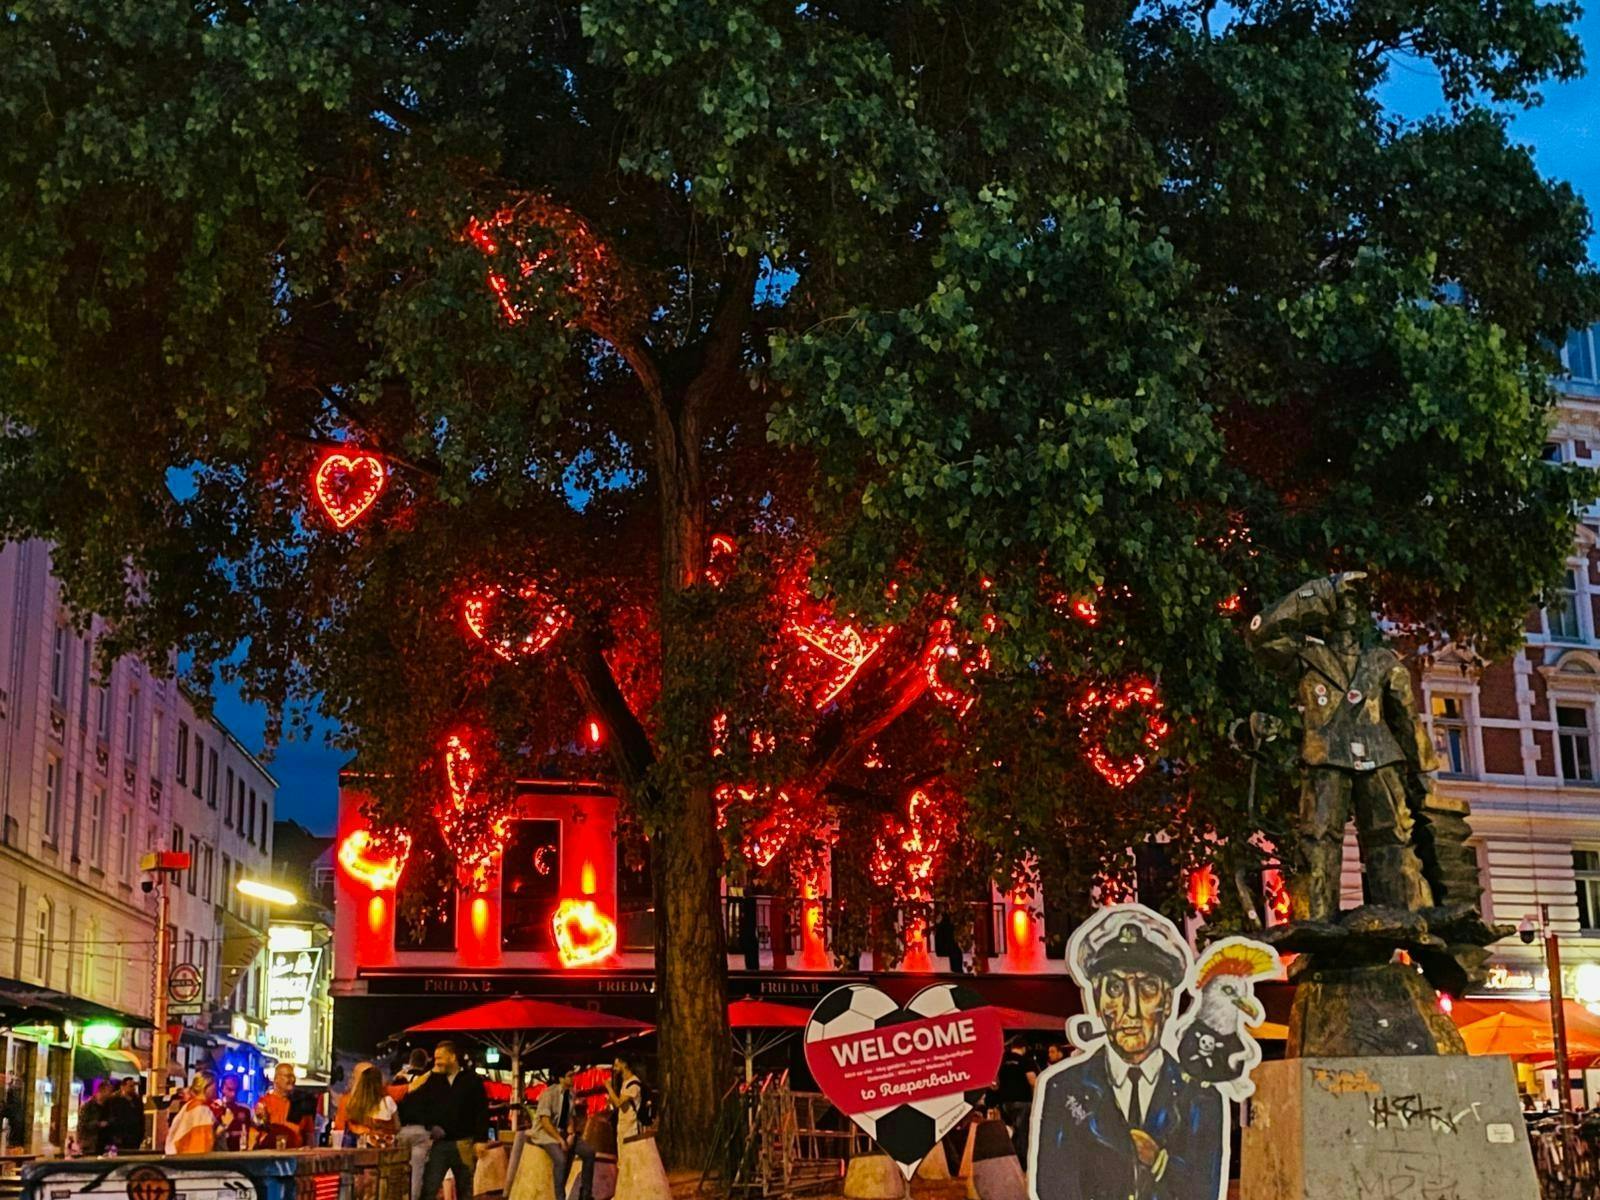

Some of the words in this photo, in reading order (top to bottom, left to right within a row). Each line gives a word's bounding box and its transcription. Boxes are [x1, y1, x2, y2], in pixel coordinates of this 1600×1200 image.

[424, 979, 479, 992] FRIEDA
[598, 981, 649, 992] FRIEDA
[831, 1018, 977, 1067] WELCOME
[861, 1089, 876, 1100] to
[880, 1070, 971, 1096] Reeperbahn
